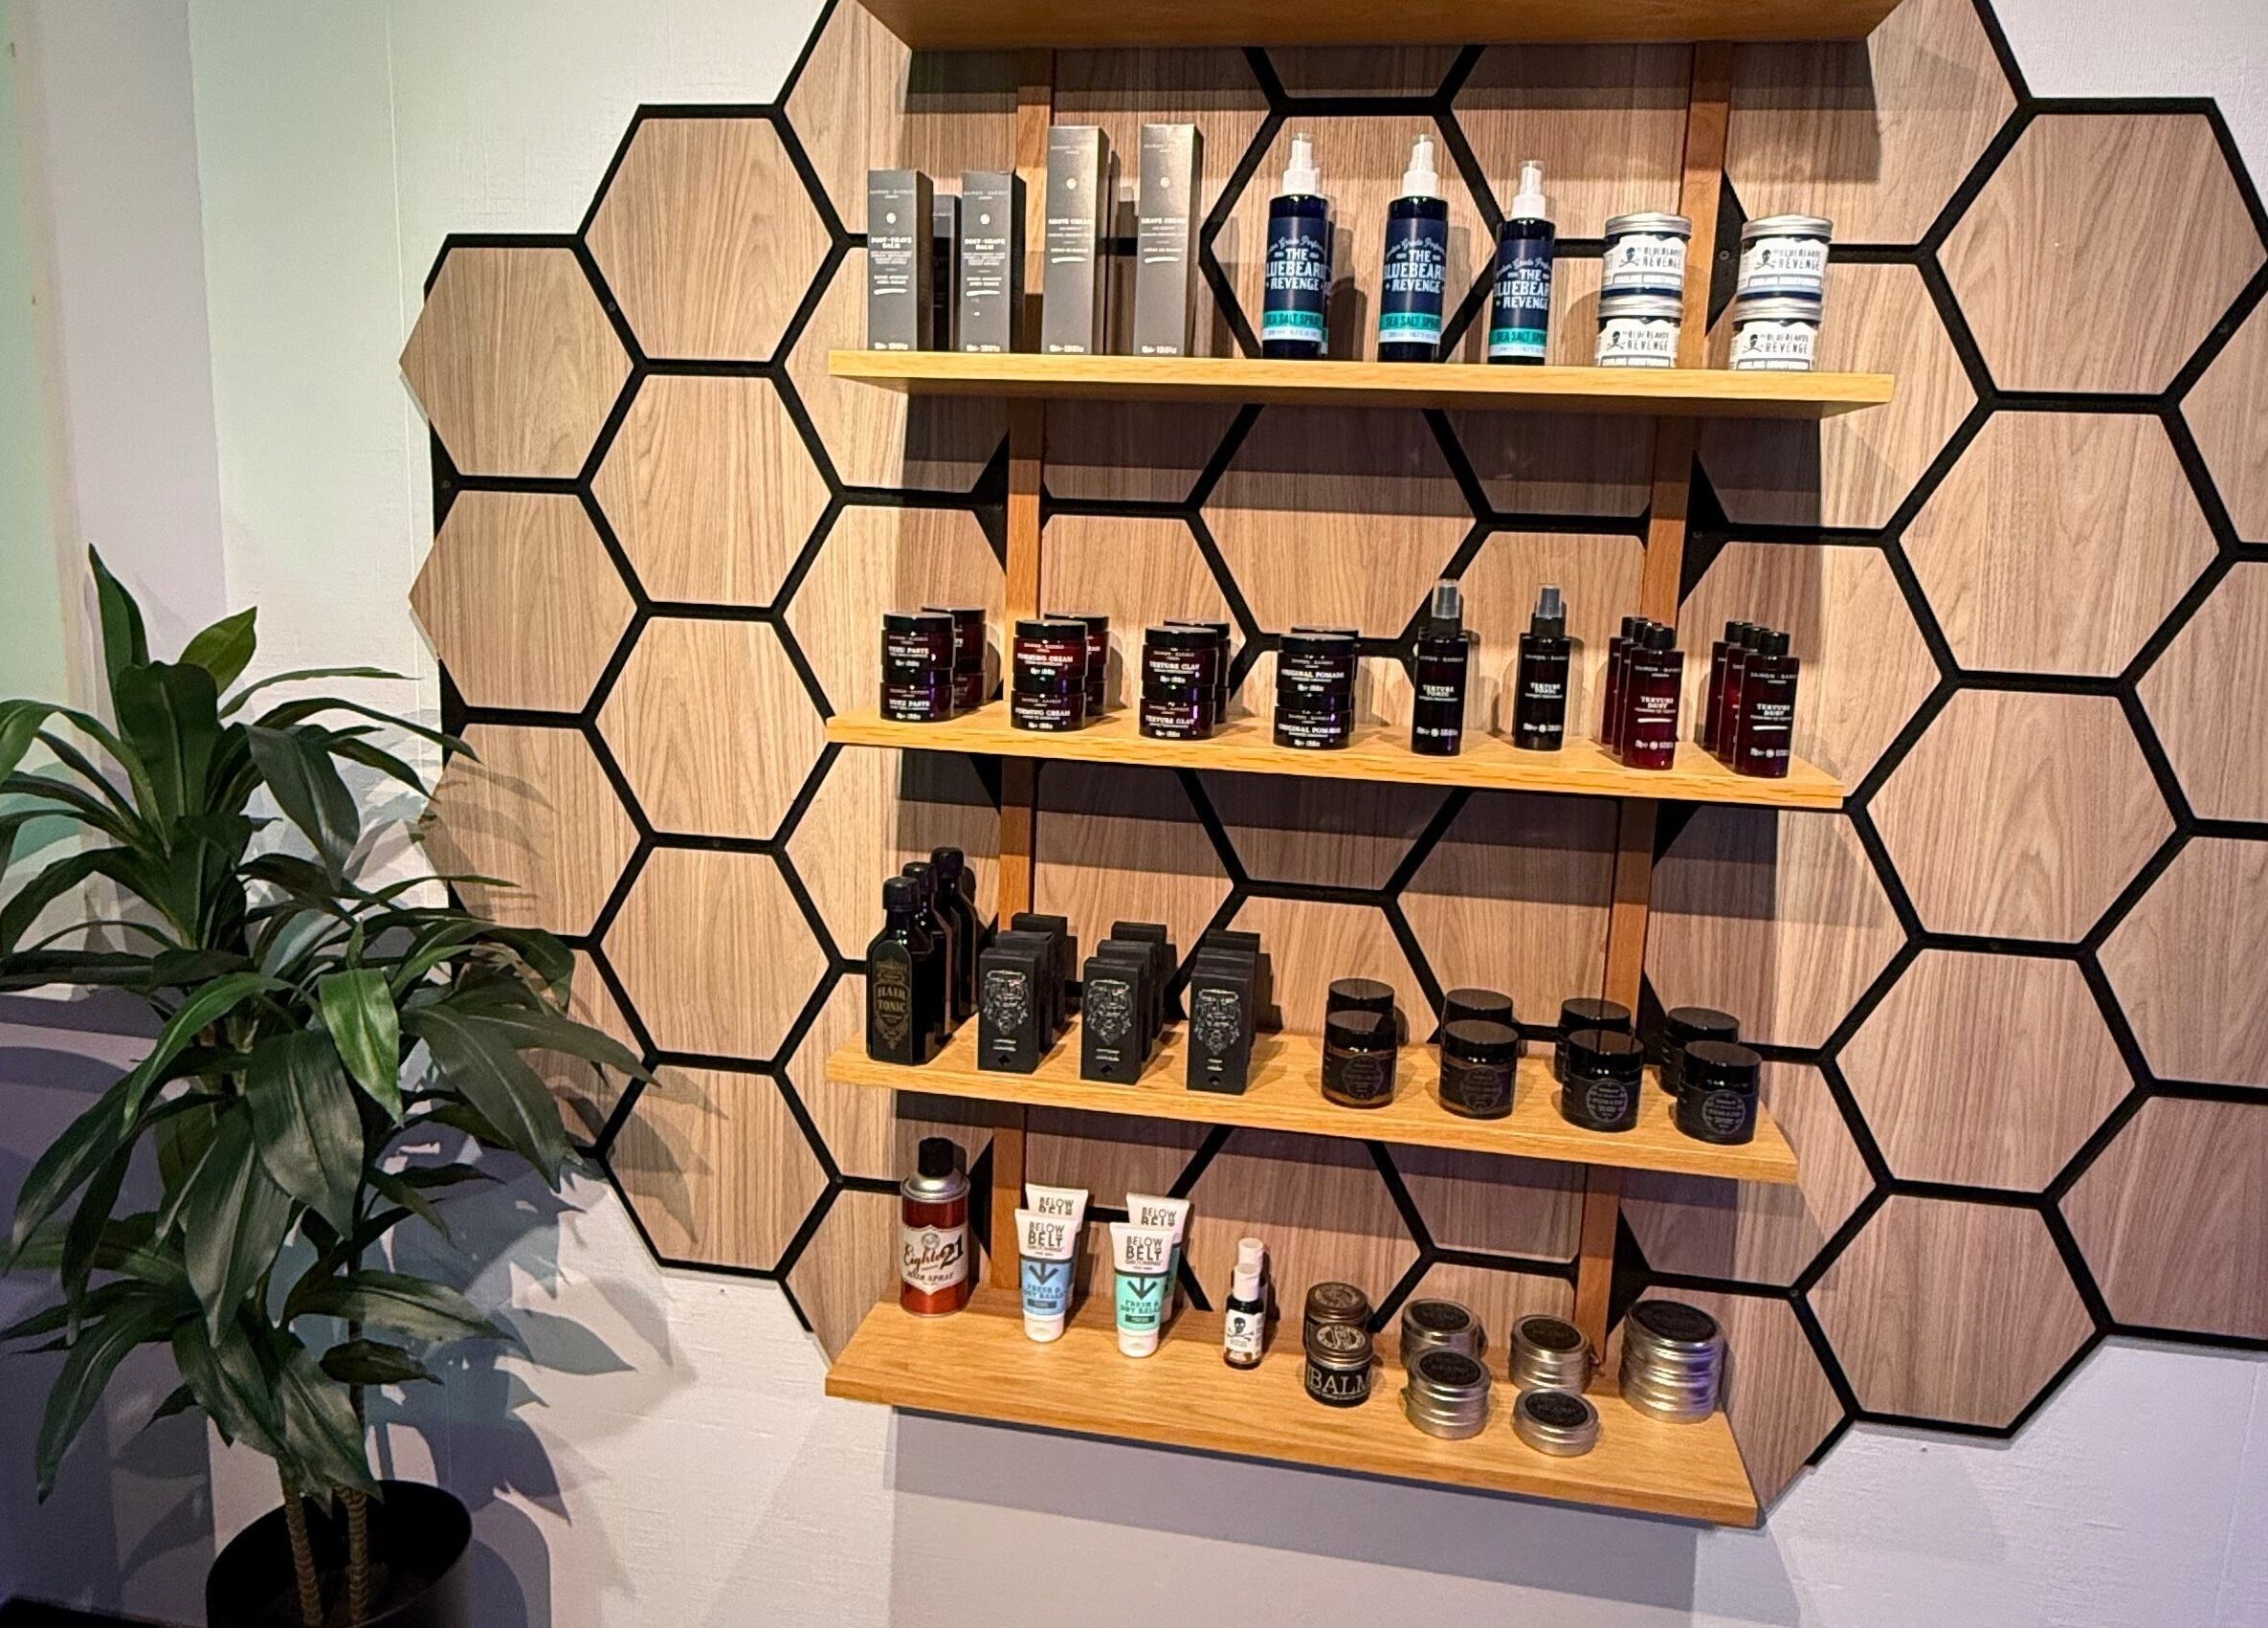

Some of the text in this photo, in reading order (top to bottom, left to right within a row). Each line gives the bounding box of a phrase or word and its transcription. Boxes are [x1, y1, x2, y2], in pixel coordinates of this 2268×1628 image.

[1285, 248, 1309, 260] THE
[1409, 249, 1432, 262] THE
[1643, 256, 1681, 269] REVENGE
[1779, 258, 1820, 271] REVENGE
[1519, 269, 1543, 280] THE
[1270, 277, 1320, 291] REVENGE
[1391, 279, 1440, 294] REVENGE
[1627, 339, 1669, 350] REVENGE
[1766, 342, 1808, 354] REVENGE
[878, 986, 906, 1000] HAIR
[878, 999, 906, 1012] TONIC
[1039, 1196, 1074, 1208] BELOW
[1142, 1206, 1176, 1218] BELOW
[1029, 1221, 1065, 1234] BELOW
[1028, 1231, 1063, 1247] BELT
[1126, 1236, 1164, 1247] BELOW
[1125, 1245, 1162, 1260] BELT
